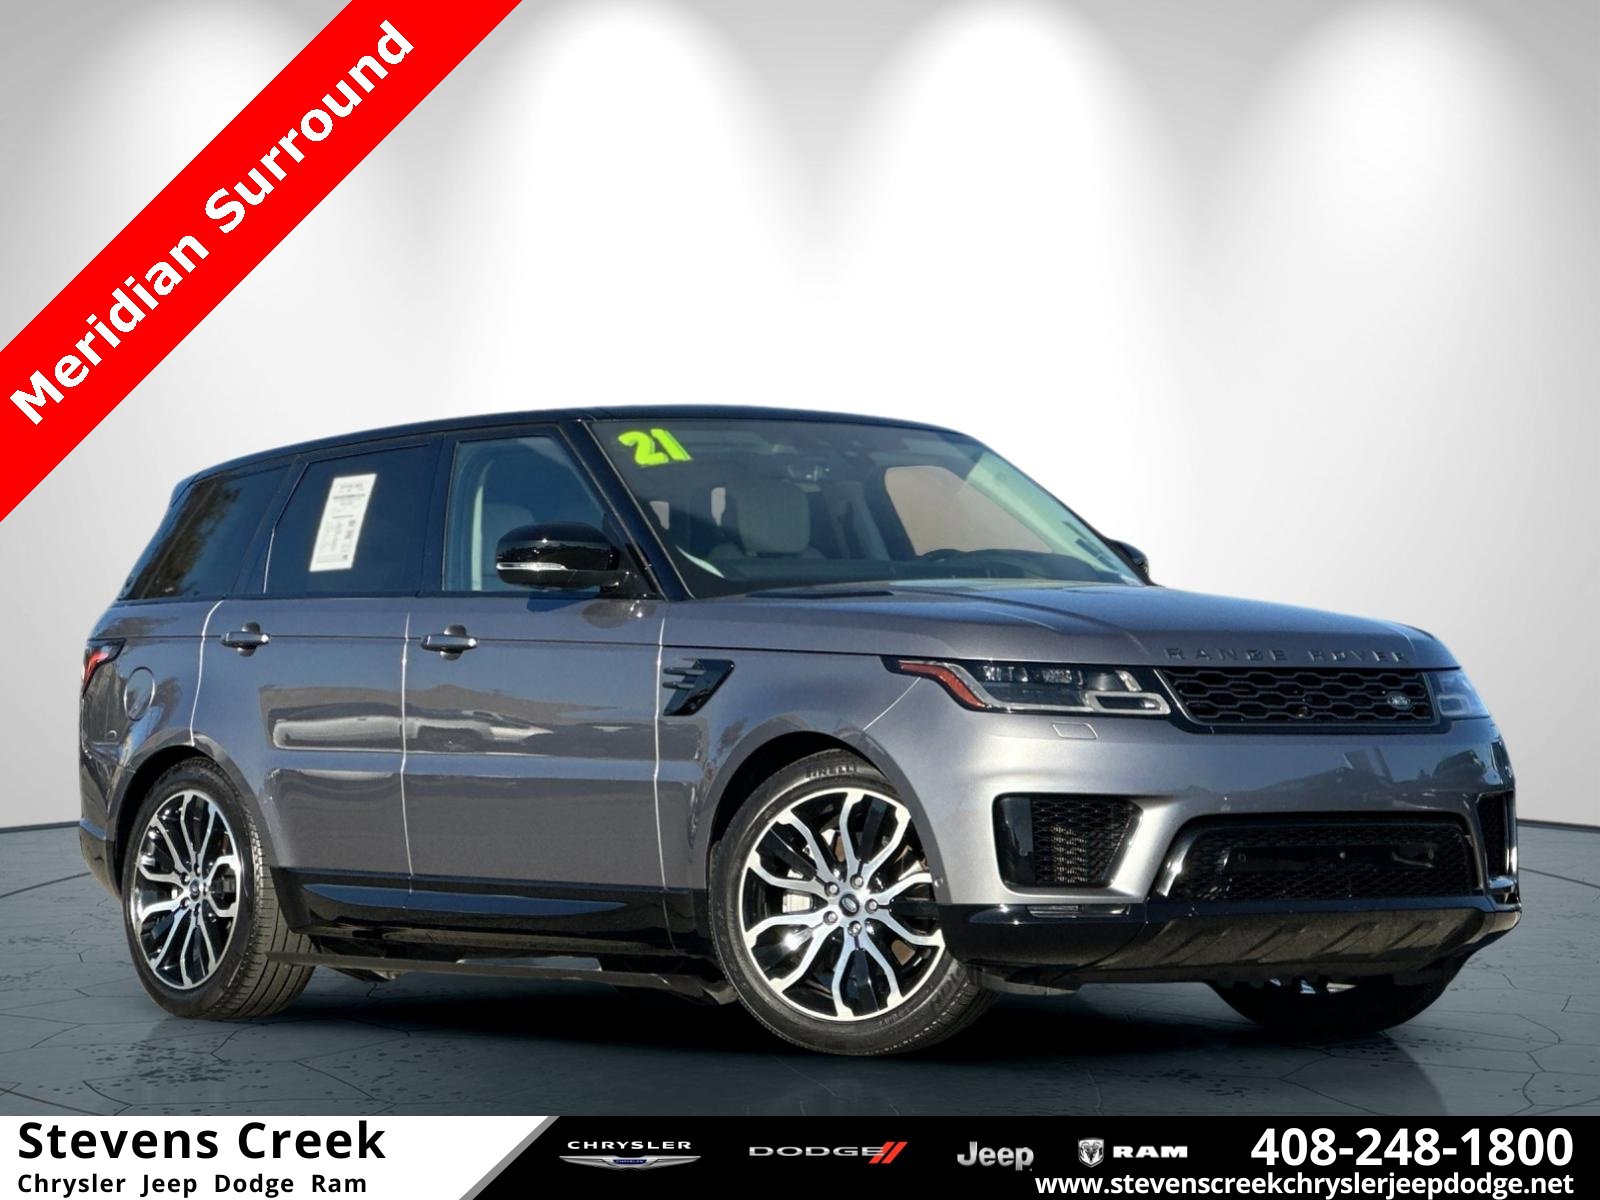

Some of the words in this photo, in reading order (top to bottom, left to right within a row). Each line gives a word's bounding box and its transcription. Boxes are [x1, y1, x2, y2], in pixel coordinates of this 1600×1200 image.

[618, 428, 690, 466] 21
[1164, 648, 1287, 662] RANGE
[1308, 649, 1408, 663] ROVER
